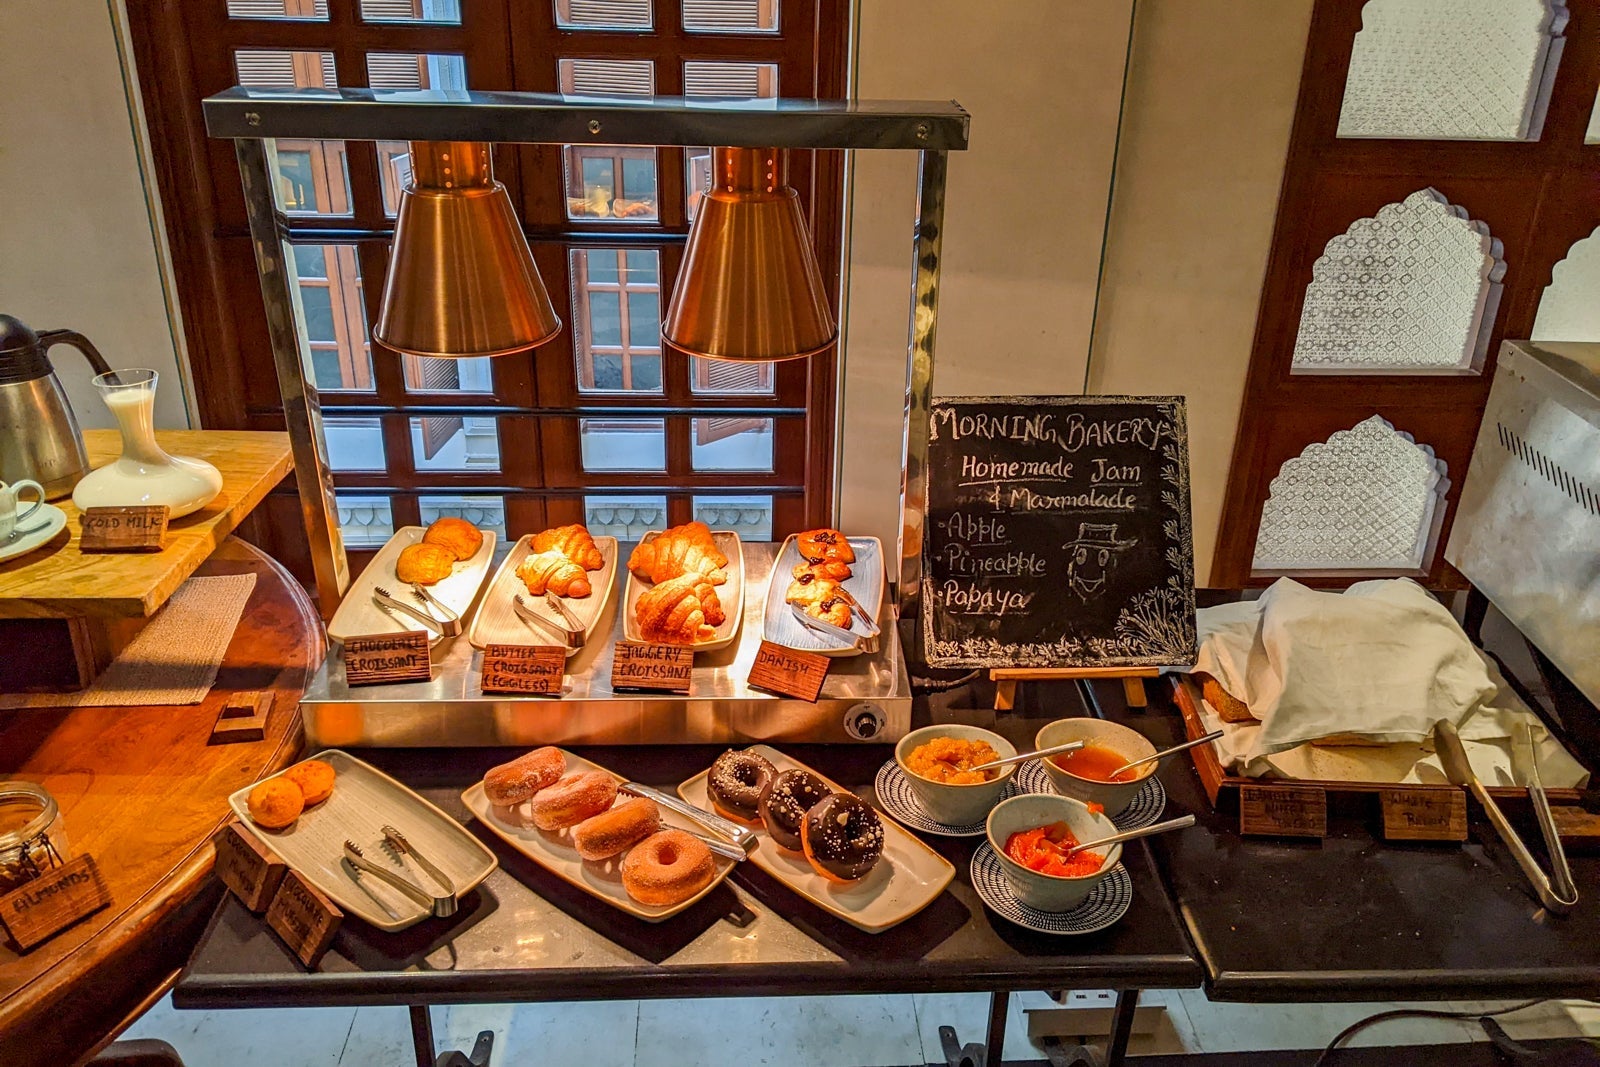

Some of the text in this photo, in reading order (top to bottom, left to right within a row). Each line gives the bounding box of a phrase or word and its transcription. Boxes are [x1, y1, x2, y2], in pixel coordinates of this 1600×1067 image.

[930, 408, 1164, 453] MORNING BAKERY
[962, 455, 1141, 483] Homemade Jam
[1009, 488, 1137, 511] Marmalade
[87, 514, 162, 529] COLD MILK
[947, 511, 1006, 543] Apple
[944, 543, 1046, 574] Pineapple
[944, 579, 1027, 614] Papaya
[351, 654, 418, 671] CROISSANT
[491, 646, 536, 659] BUTTER
[622, 645, 681, 662] JAGGERY
[760, 650, 809, 674] DANISH
[493, 661, 559, 676] CROISSANT
[620, 663, 691, 679] CROISSANT
[12, 869, 90, 913] ALMONDS
